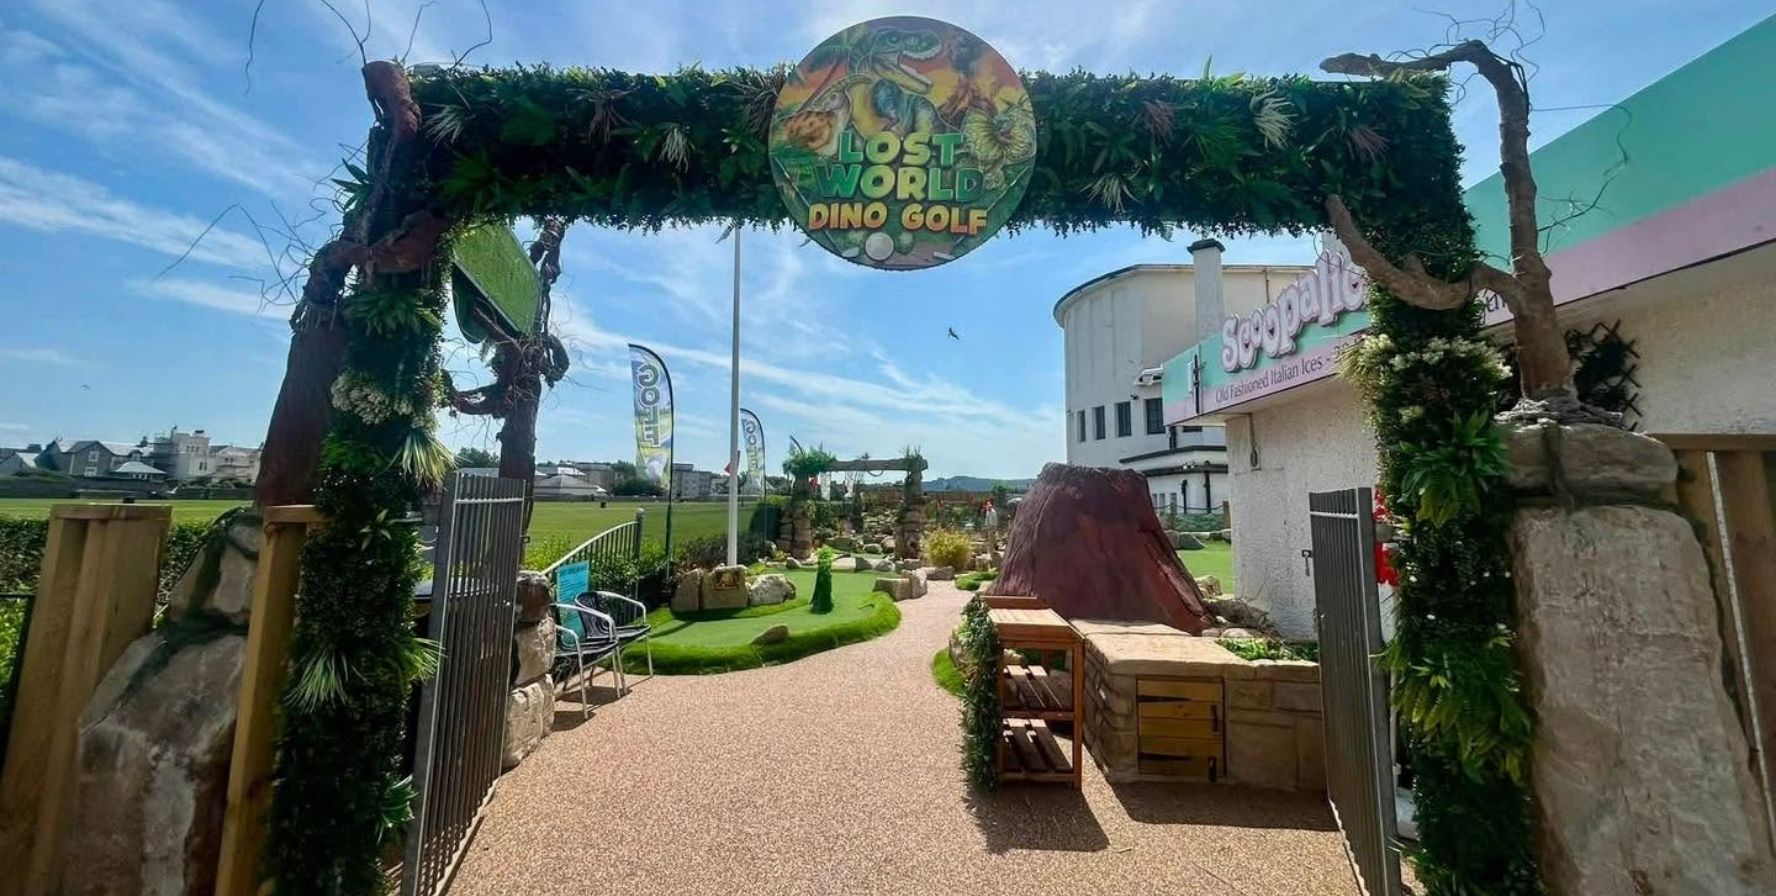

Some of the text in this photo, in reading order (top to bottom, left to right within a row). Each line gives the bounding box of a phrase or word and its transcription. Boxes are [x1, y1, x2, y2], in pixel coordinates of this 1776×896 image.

[838, 131, 963, 167] LOST
[815, 165, 985, 201] WORLD
[808, 202, 988, 235] DINO GOLF
[1215, 385, 1229, 404] Old
[1230, 371, 1269, 398] Fashioned
[1270, 364, 1300, 384] Italian
[1301, 356, 1323, 375] Ices
